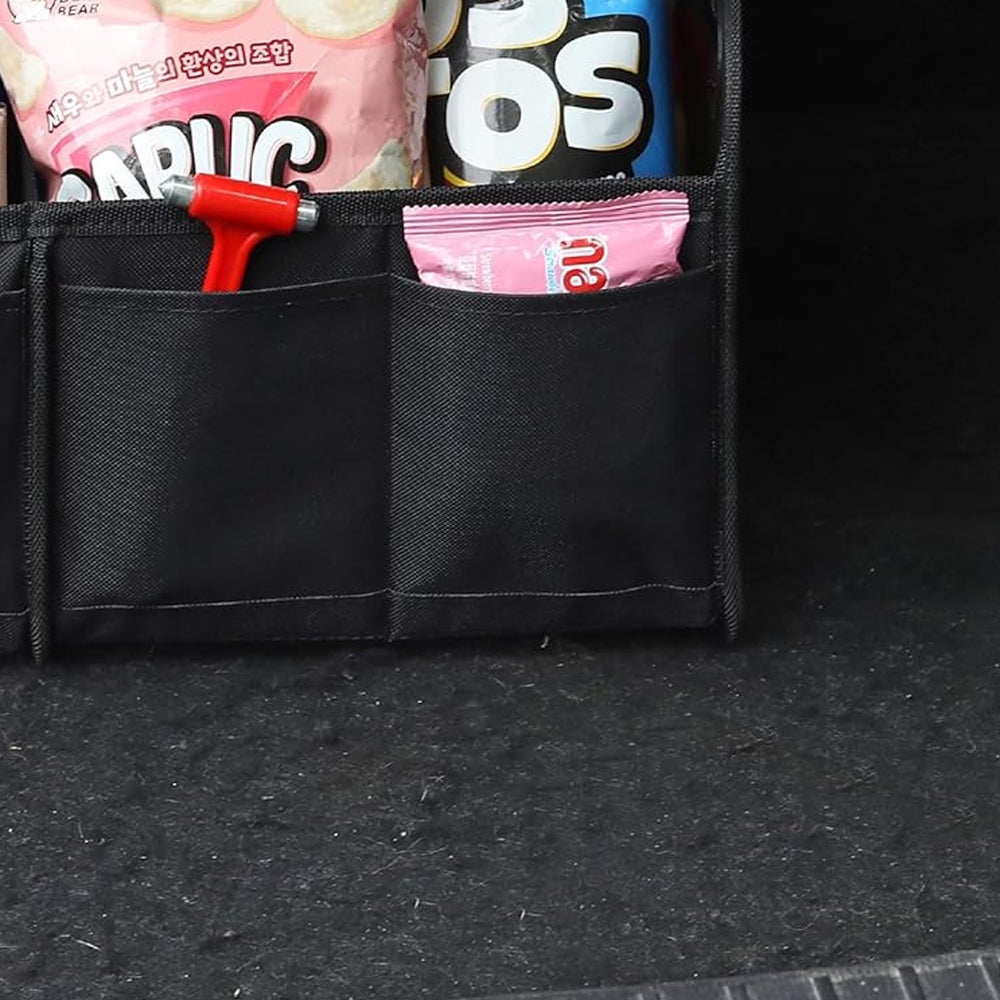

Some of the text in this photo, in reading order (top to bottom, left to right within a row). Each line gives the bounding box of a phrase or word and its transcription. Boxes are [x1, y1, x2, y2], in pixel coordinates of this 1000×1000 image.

[58, 3, 99, 17] BEAR
[105, 57, 177, 99] 마늘의
[180, 43, 246, 79] 환상의
[249, 38, 294, 67] 조합
